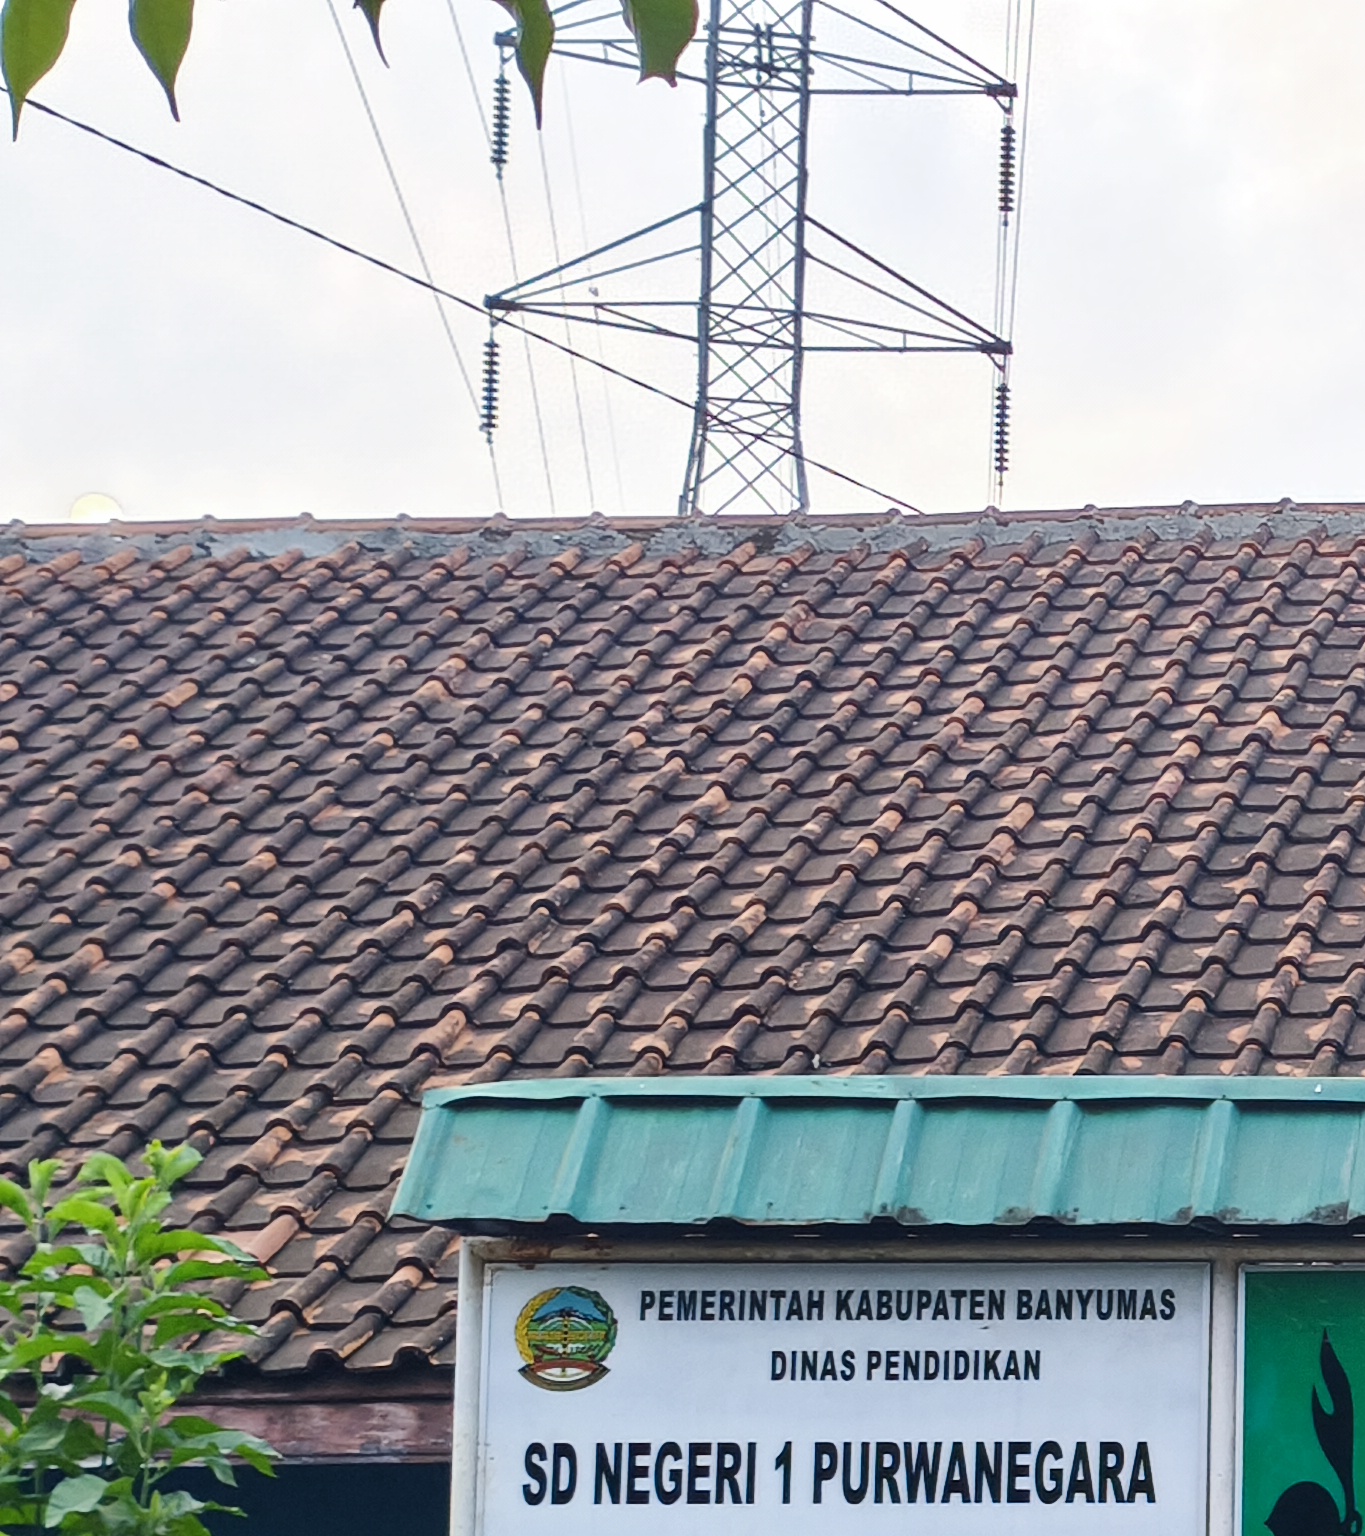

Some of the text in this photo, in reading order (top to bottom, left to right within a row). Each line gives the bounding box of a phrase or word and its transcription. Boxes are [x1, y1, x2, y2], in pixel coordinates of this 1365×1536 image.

[640, 1289, 1175, 1320] PEMERINTAH KABUPATEN BANYUMAS
[771, 1350, 1040, 1381] DINAS PENDIDIKAN
[523, 1441, 1156, 1505] SD NEGERI 1 PURWANEGARA
